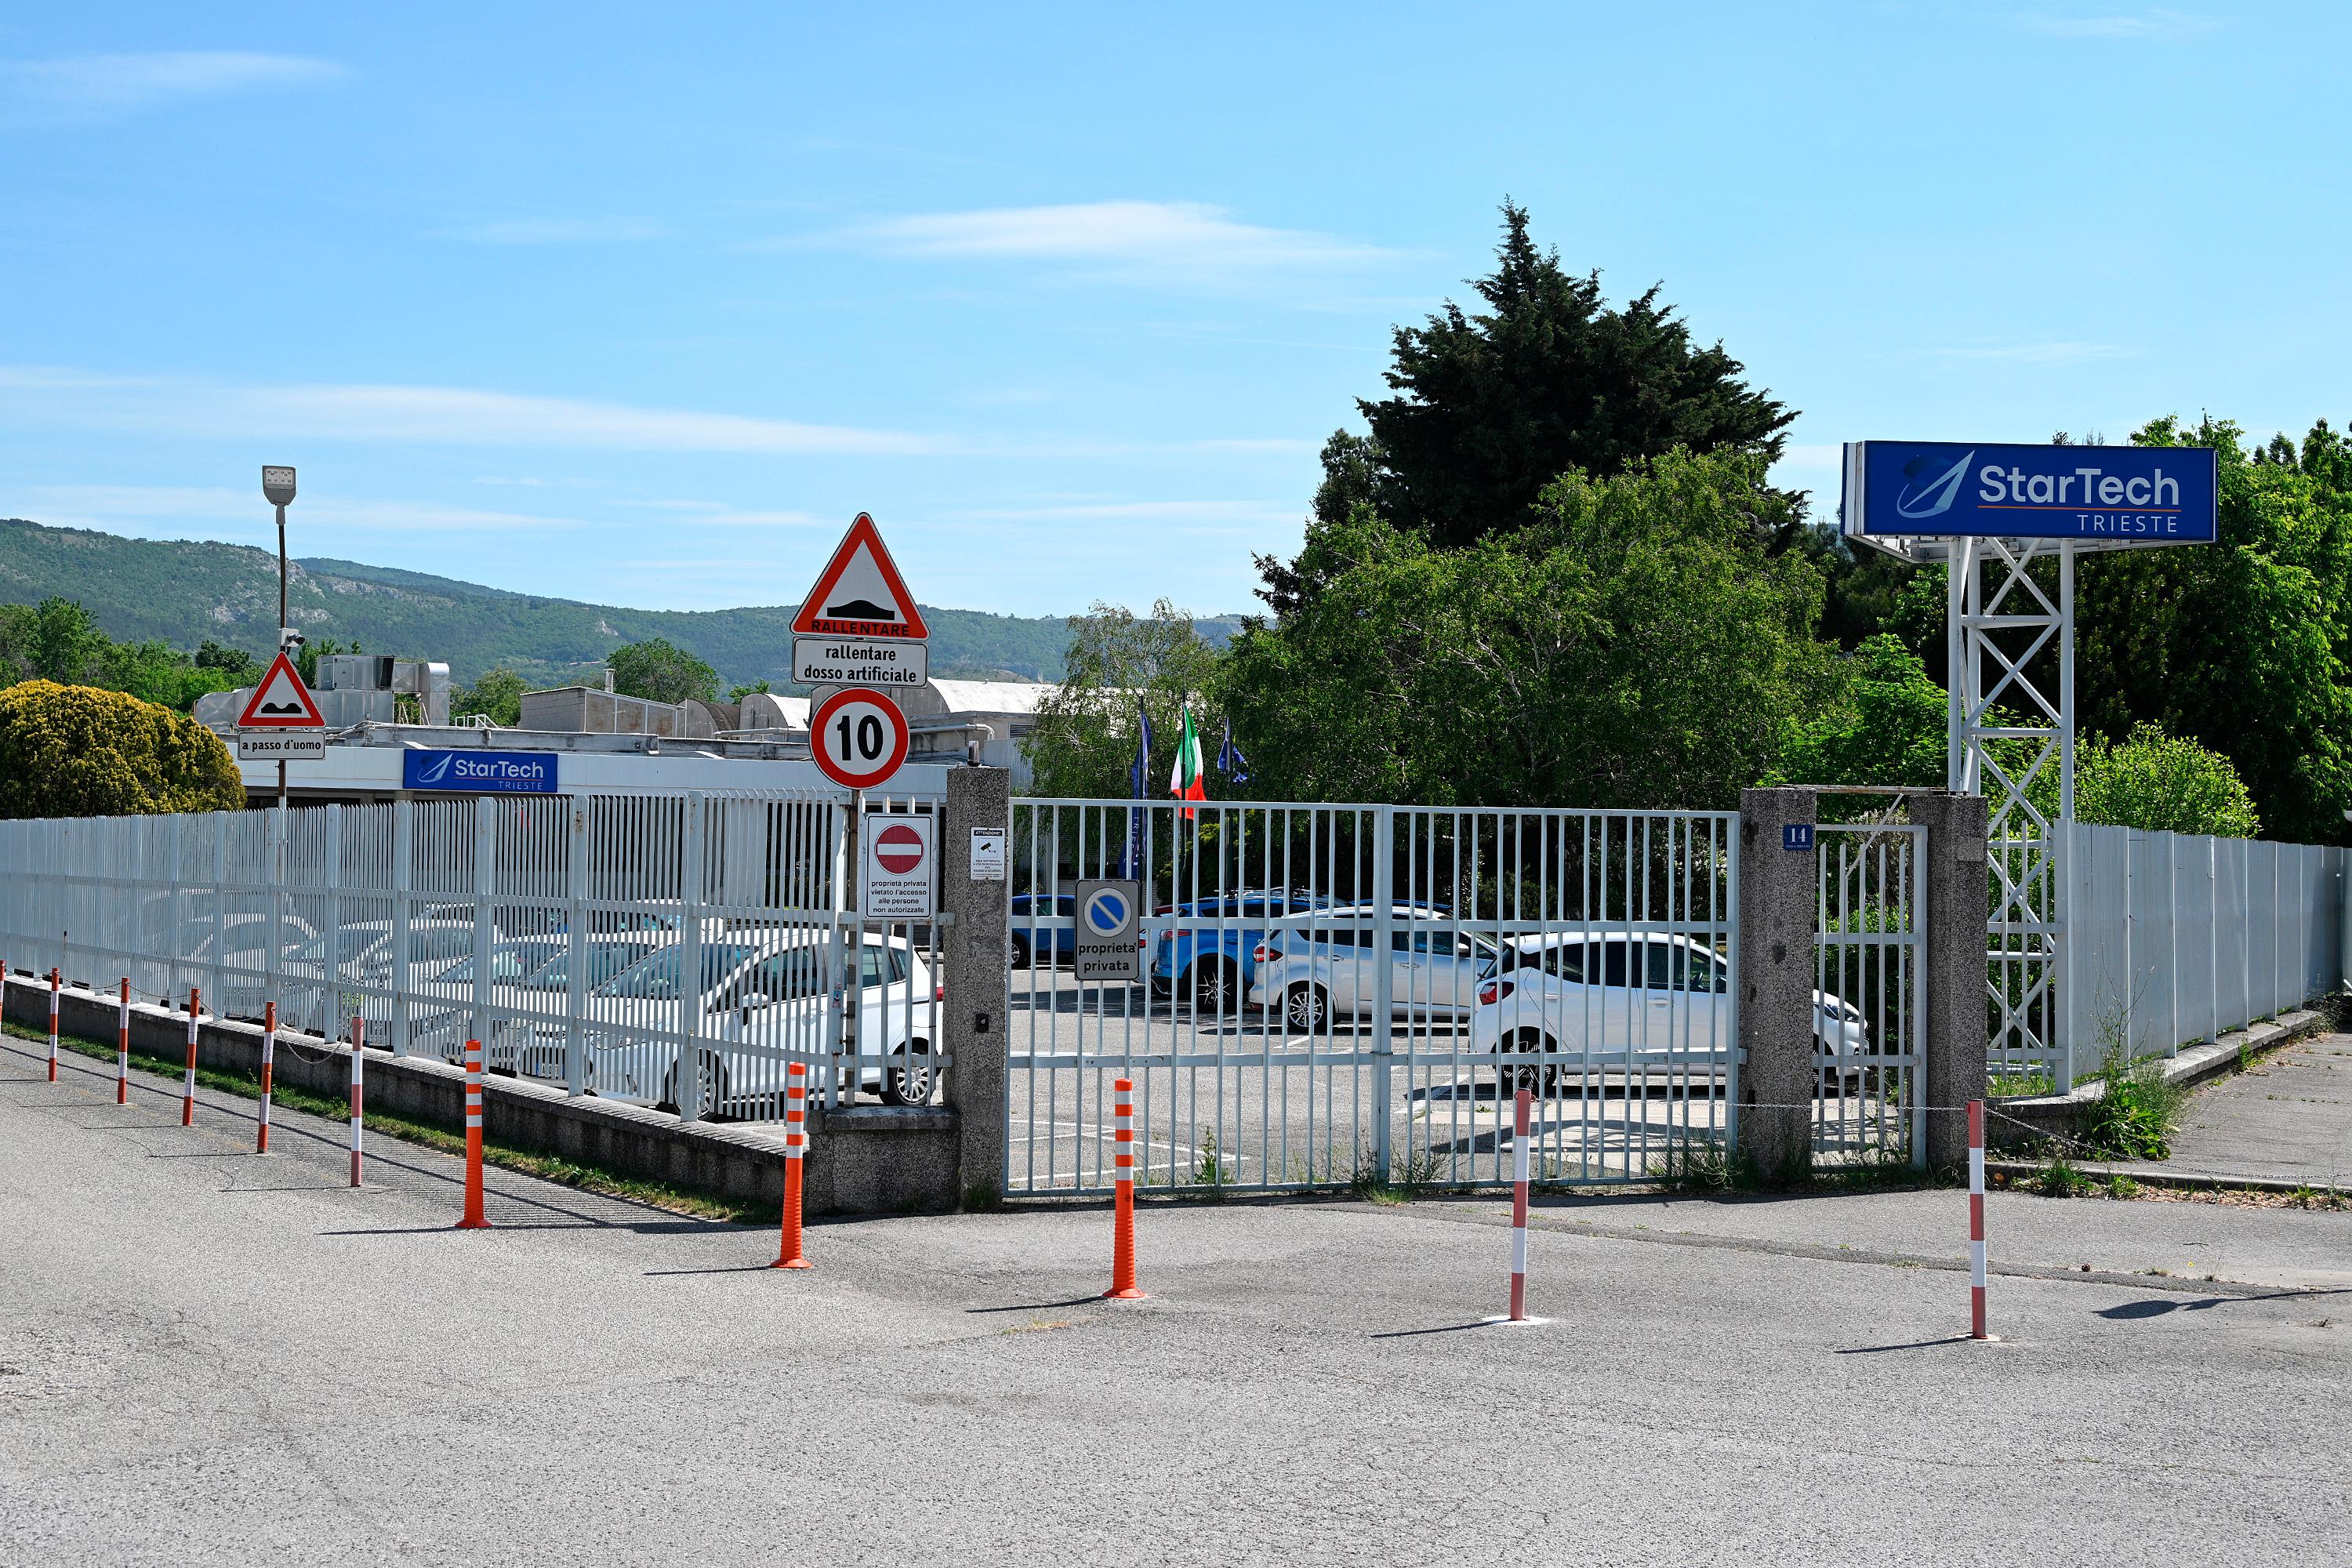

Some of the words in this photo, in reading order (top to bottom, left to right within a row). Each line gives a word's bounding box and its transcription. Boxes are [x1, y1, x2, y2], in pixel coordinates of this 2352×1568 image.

[1979, 465, 2180, 506] StarTech
[2076, 514, 2178, 532] TRIESTE
[811, 620, 909, 636] RALLENTARE
[826, 644, 896, 661] rallentare
[804, 664, 843, 680] dosso
[847, 666, 916, 682] artificiale
[837, 714, 884, 760] 10
[241, 742, 249, 750] a
[252, 742, 281, 753] passo
[284, 739, 321, 750] d'uomo
[455, 759, 544, 779] StarTech
[498, 781, 543, 790] TRIESTE
[1790, 827, 1806, 843] 14
[1083, 960, 1130, 973] privata
